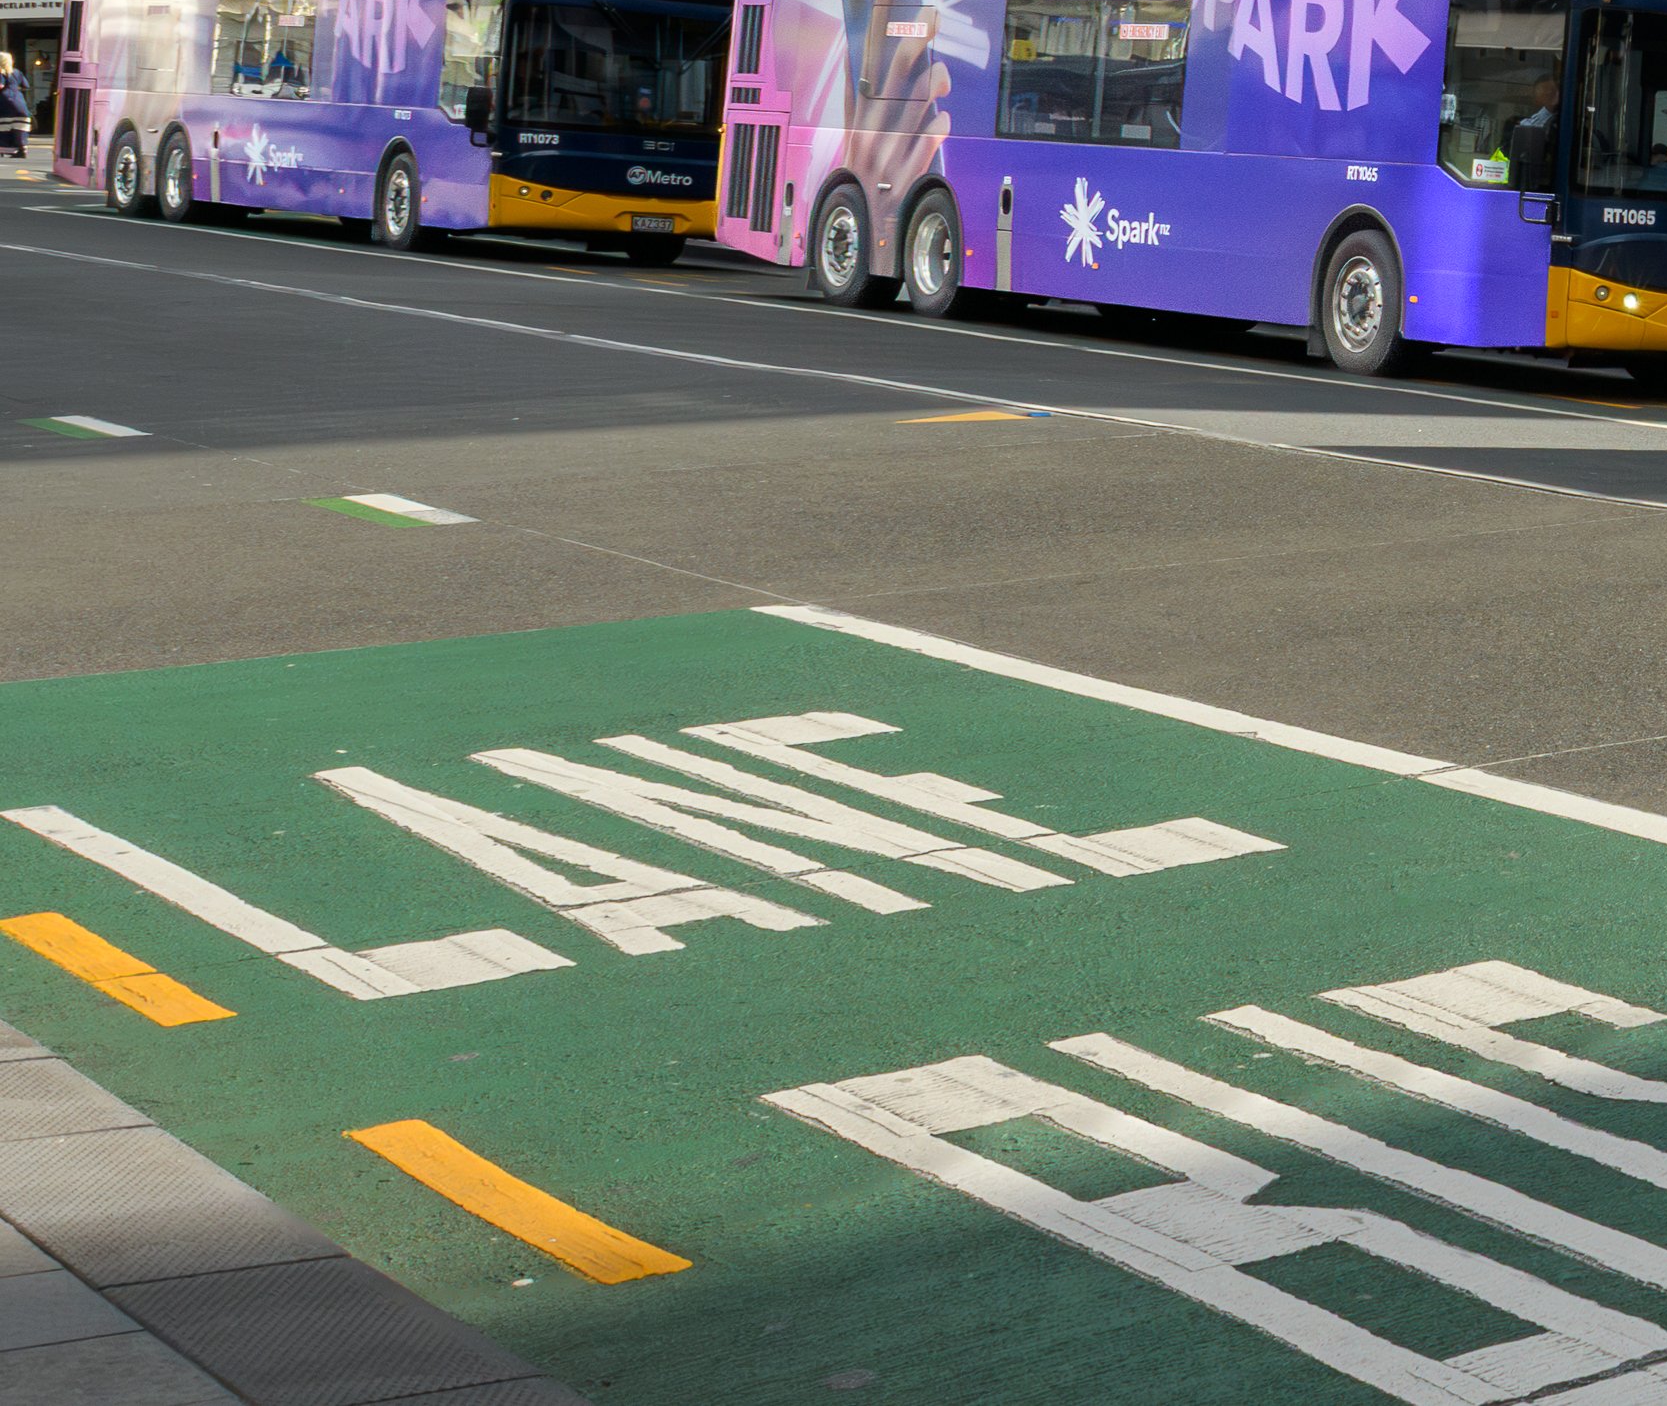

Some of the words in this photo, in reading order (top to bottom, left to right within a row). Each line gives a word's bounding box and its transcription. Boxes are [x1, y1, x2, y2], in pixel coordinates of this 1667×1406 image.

[518, 132, 560, 145] RT1073
[647, 170, 693, 186] Metro
[1347, 165, 1378, 182] RT1065
[1603, 207, 1656, 226] RT1065
[1106, 208, 1160, 250] Spark
[4, 710, 1288, 1002] LANE
